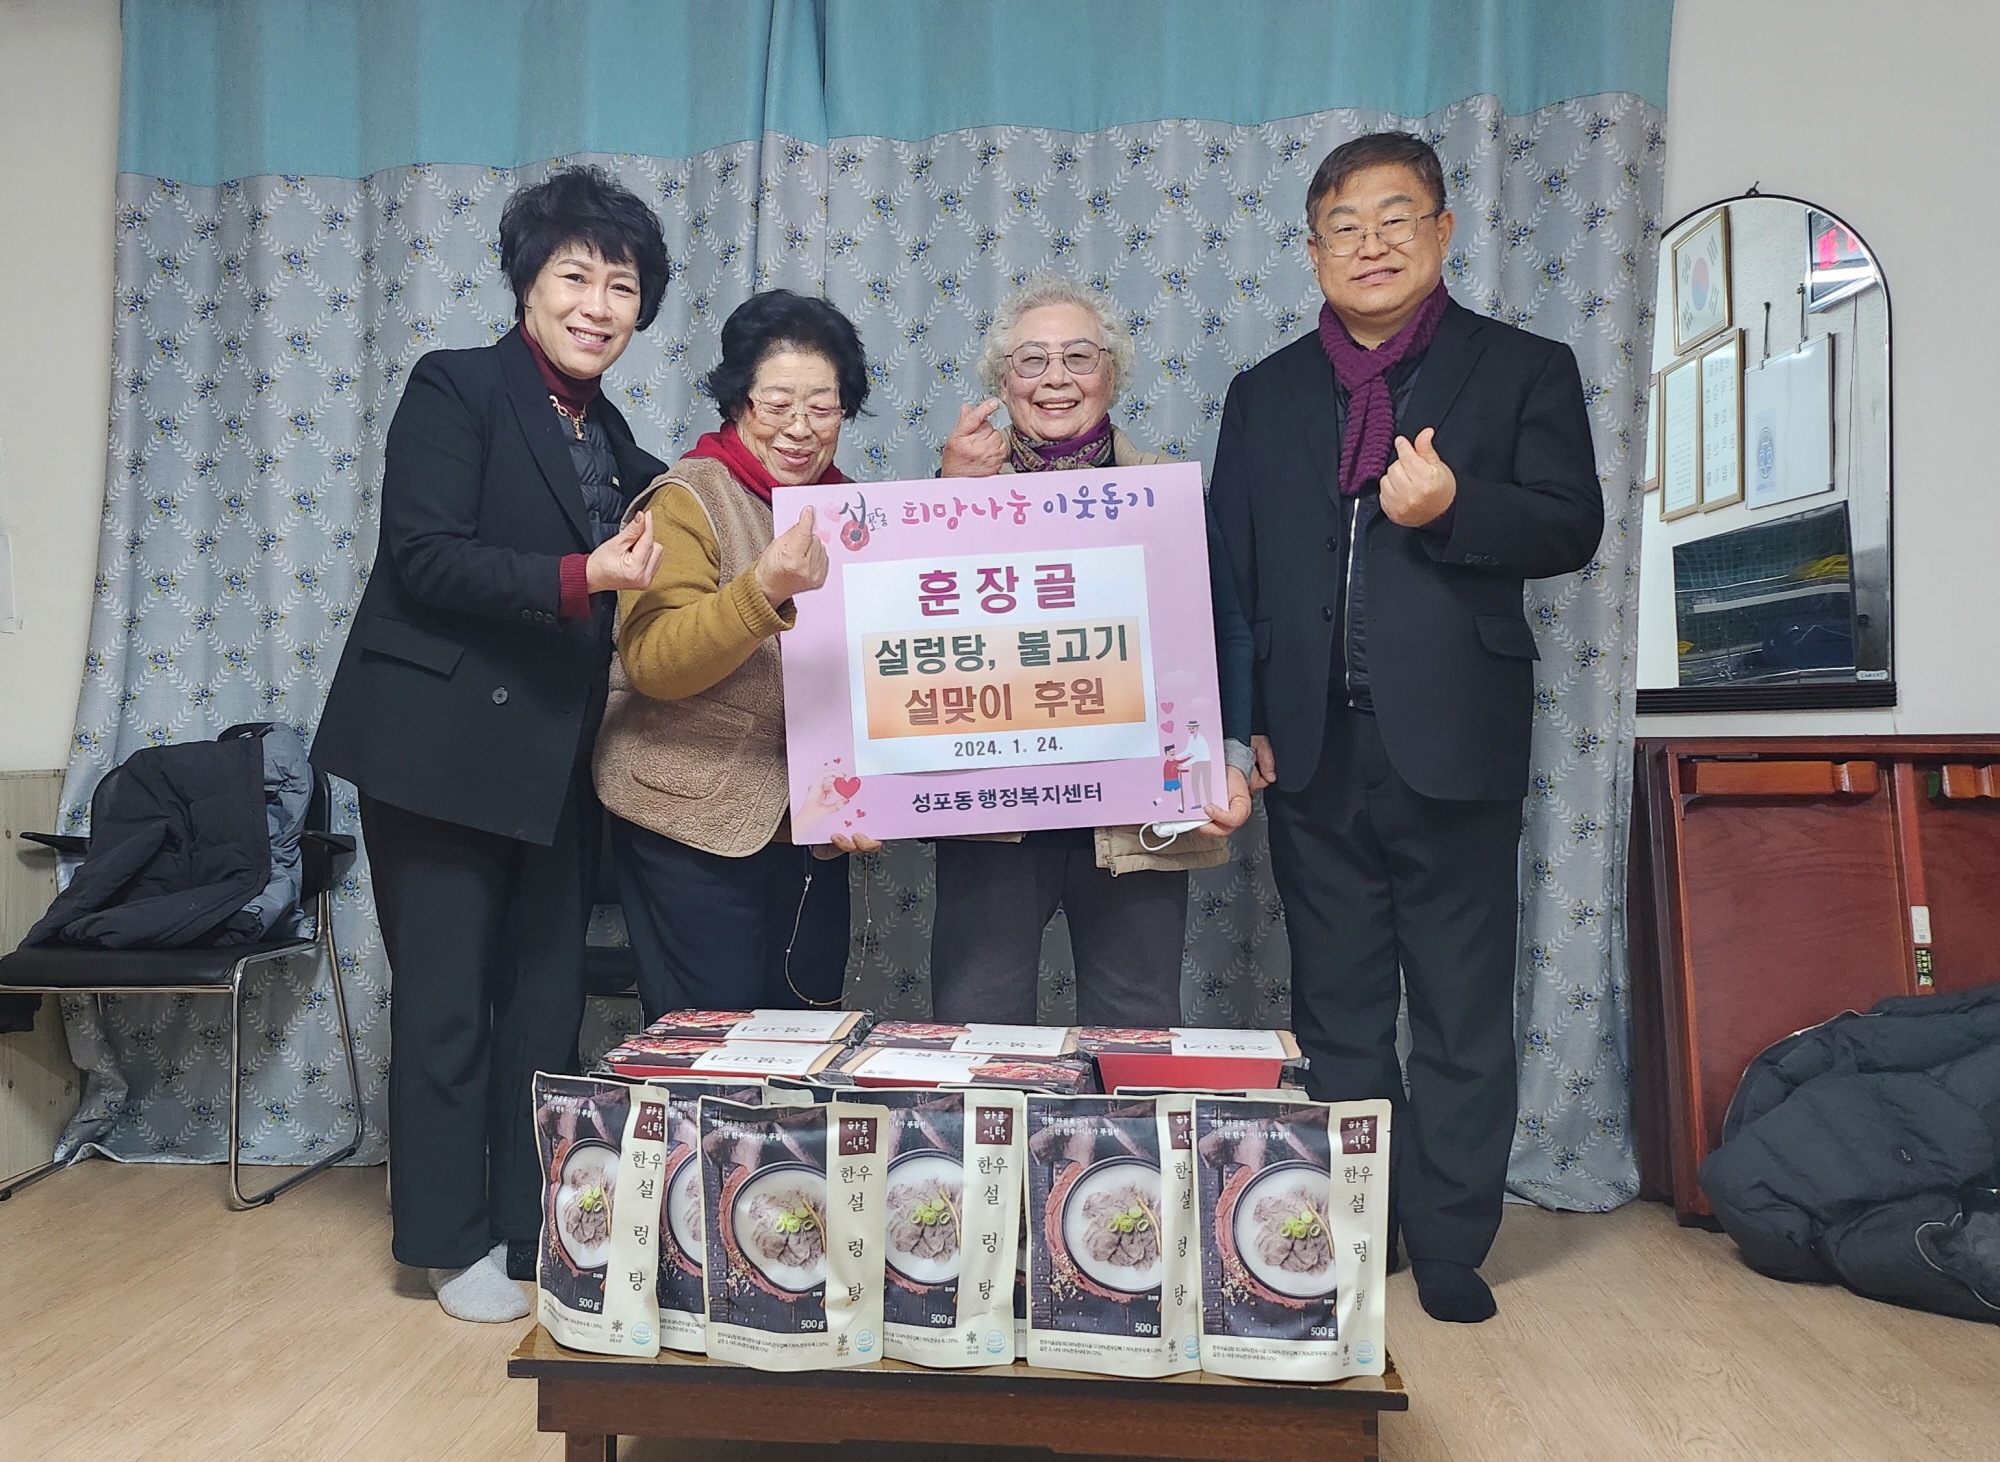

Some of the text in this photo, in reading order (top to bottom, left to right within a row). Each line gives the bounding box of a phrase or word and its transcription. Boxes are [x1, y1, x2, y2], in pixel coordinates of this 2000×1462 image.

[901, 481, 1156, 531] 희망나눔 이웃돕기
[874, 624, 1128, 677] 설렁탕, 불고기
[904, 677, 1106, 726] 설맞이 후원
[954, 734, 1064, 758] 2024. 1. 24.
[911, 782, 1102, 813] 성포동 행정복지센터
[646, 1106, 663, 1122] 하루
[983, 1110, 1005, 1125] 하루
[641, 1122, 663, 1137] 식탁
[846, 1121, 869, 1135] 하루
[983, 1126, 1006, 1141] 식탁
[1348, 1120, 1370, 1134] 하루
[846, 1135, 871, 1150] 식탁
[1349, 1134, 1371, 1148] 식탁
[631, 1150, 663, 1170] 한우
[977, 1156, 1008, 1175] 한우
[839, 1164, 873, 1183] 한우
[1343, 1165, 1373, 1184] 한우
[628, 1178, 656, 1291] 설렁탕
[978, 1185, 1000, 1300] 설렁탕
[846, 1192, 865, 1303] 설렁탕
